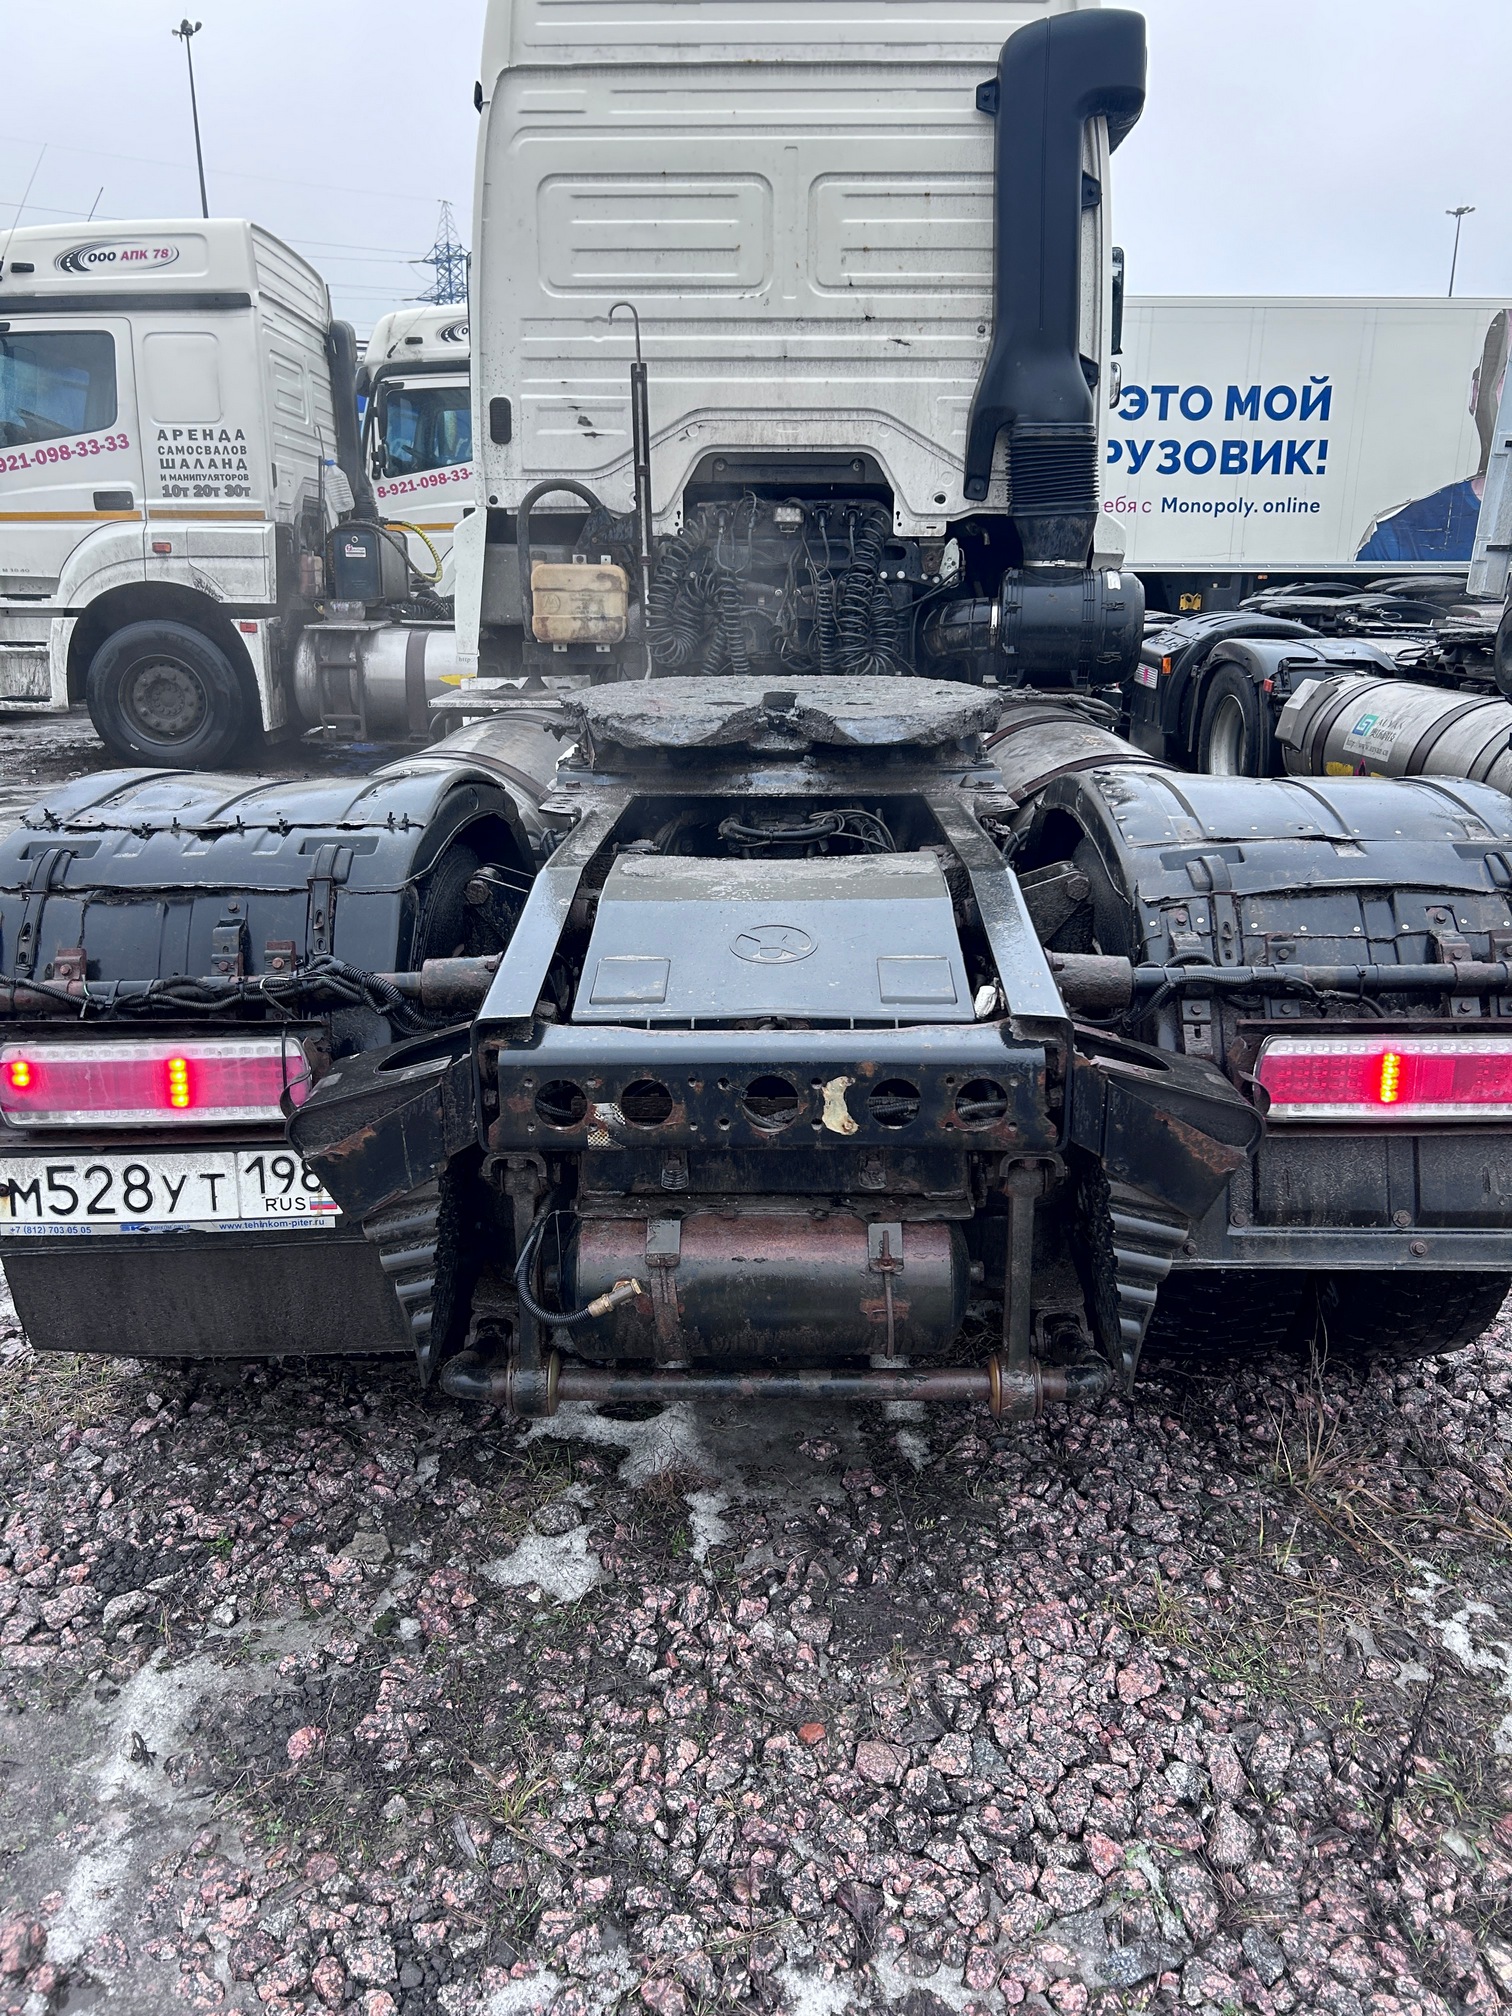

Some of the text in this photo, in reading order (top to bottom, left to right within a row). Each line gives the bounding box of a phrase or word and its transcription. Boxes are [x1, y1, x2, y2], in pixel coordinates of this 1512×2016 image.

[87, 248, 170, 263] ООО АПК 78
[1117, 376, 1333, 421] ЭТО МОЙ
[157, 428, 246, 443] АРЕНДА
[157, 445, 248, 456] САМОСВАЛОВ
[159, 458, 248, 471] ШАЛАНД
[160, 473, 250, 482] И МАНИПУЛЯТОРОВ
[1262, 496, 1320, 513] online
[244, 1156, 322, 1194] 198
[265, 1197, 306, 1212] RUS
[9, 1226, 92, 1235] +7 (812) 703 05 05
